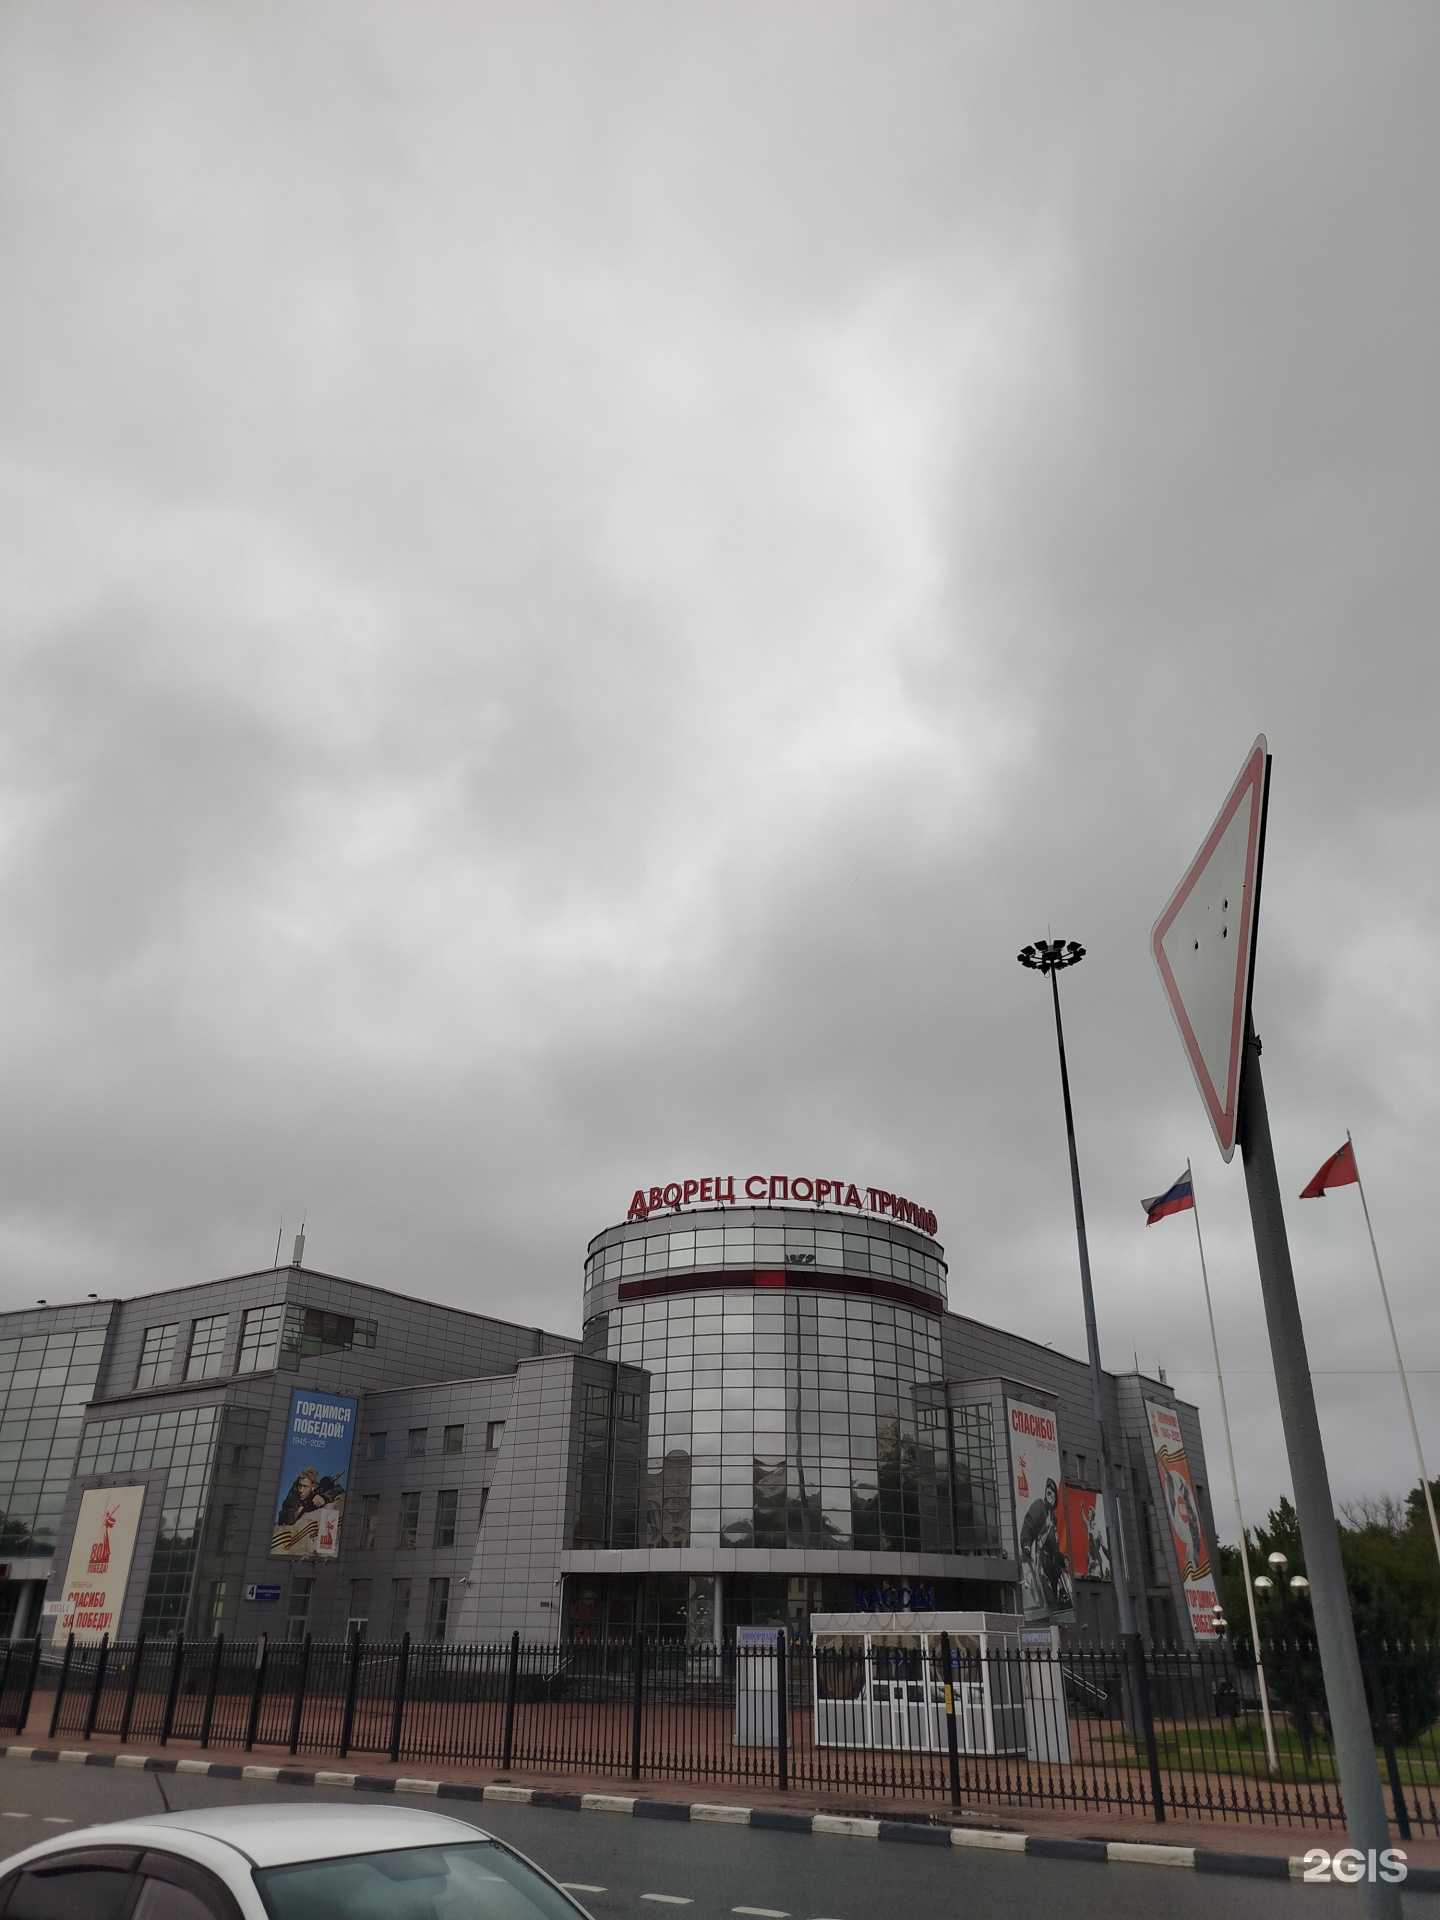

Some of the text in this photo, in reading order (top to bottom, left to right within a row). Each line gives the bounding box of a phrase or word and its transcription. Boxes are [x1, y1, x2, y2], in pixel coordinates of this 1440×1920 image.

[627, 1175, 937, 1236] ДВОРЕЦ СПОРТА ТРИУМФ
[296, 1400, 351, 1422] ГОРДИМСЯ
[293, 1418, 344, 1438] ПОБЕДОЙ!
[1012, 1409, 1056, 1440] СПАСИБО!
[63, 1613, 112, 1631] ЗА ПОБЕДУ!
